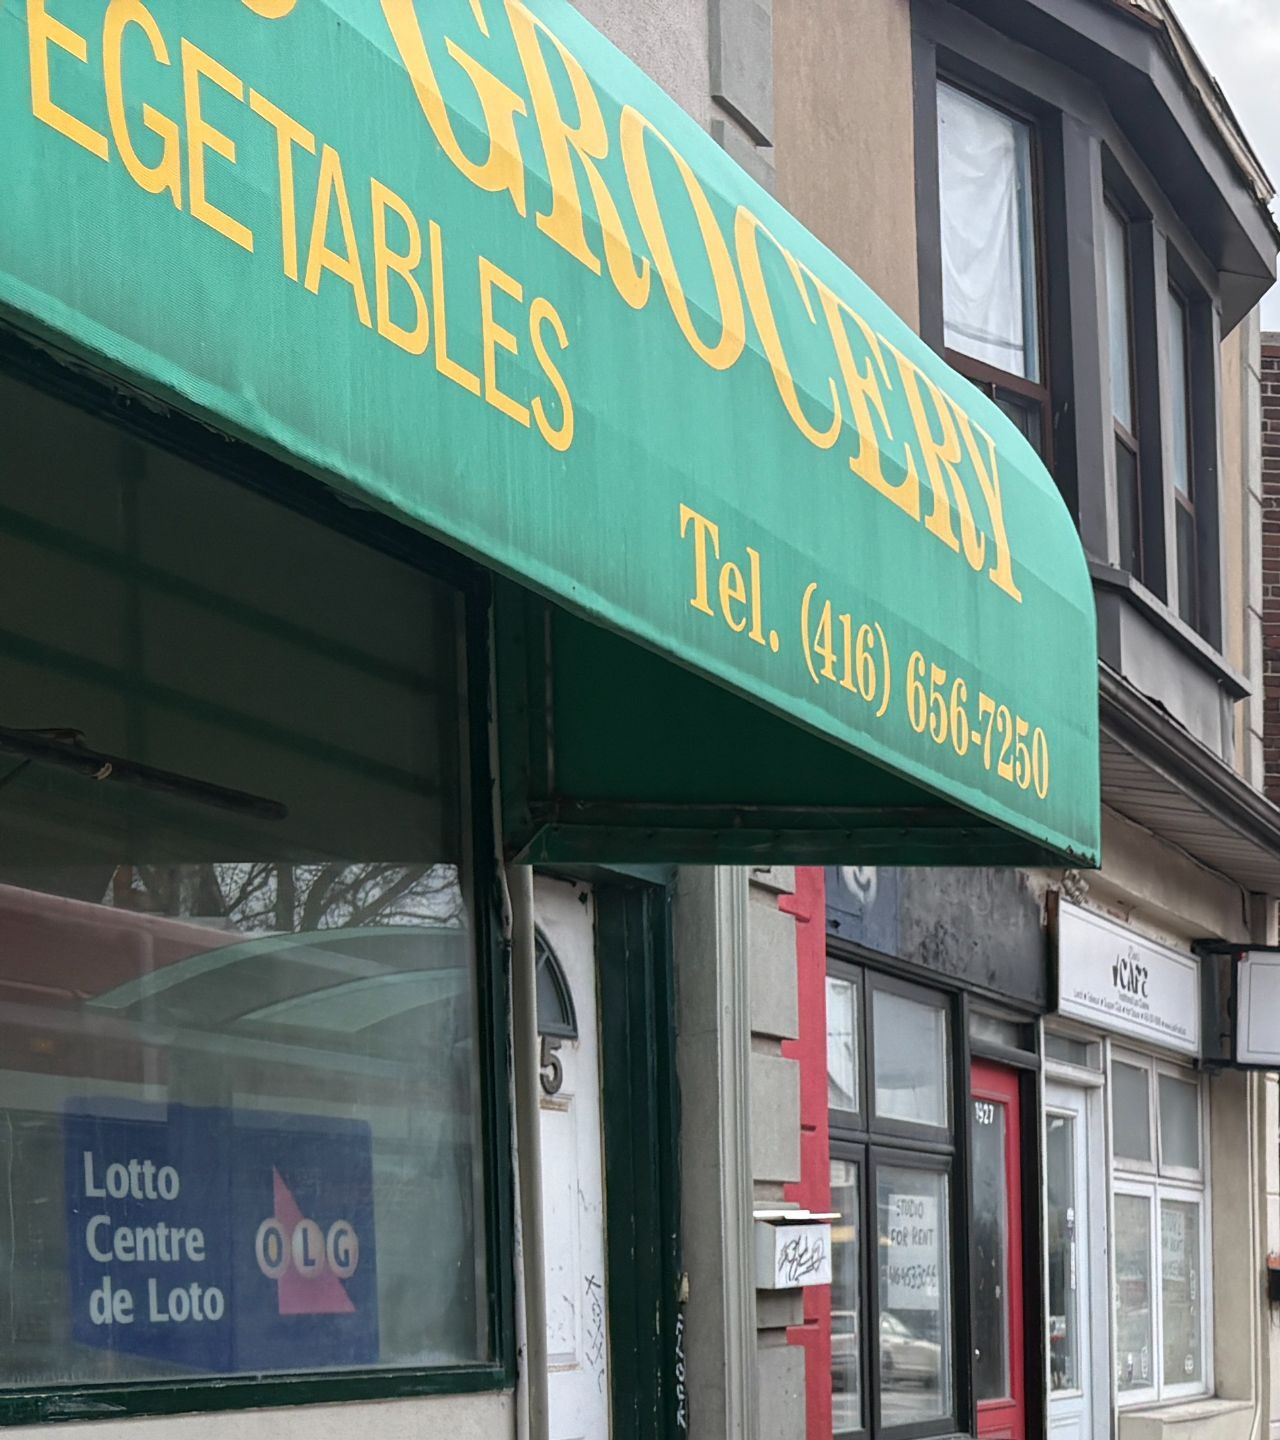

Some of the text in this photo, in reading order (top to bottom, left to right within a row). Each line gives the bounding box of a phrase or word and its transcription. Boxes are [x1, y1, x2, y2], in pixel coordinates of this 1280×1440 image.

[385, 0, 1024, 604] GROCERY
[679, 503, 1051, 801] Tel. (416) 656-7250
[975, 1102, 995, 1125] 1927
[83, 1151, 181, 1202] Lotto
[85, 1213, 206, 1265] Centre
[260, 1224, 356, 1275] OLG
[891, 1226, 934, 1248] FOR RENT
[89, 1274, 225, 1326] de Loto
